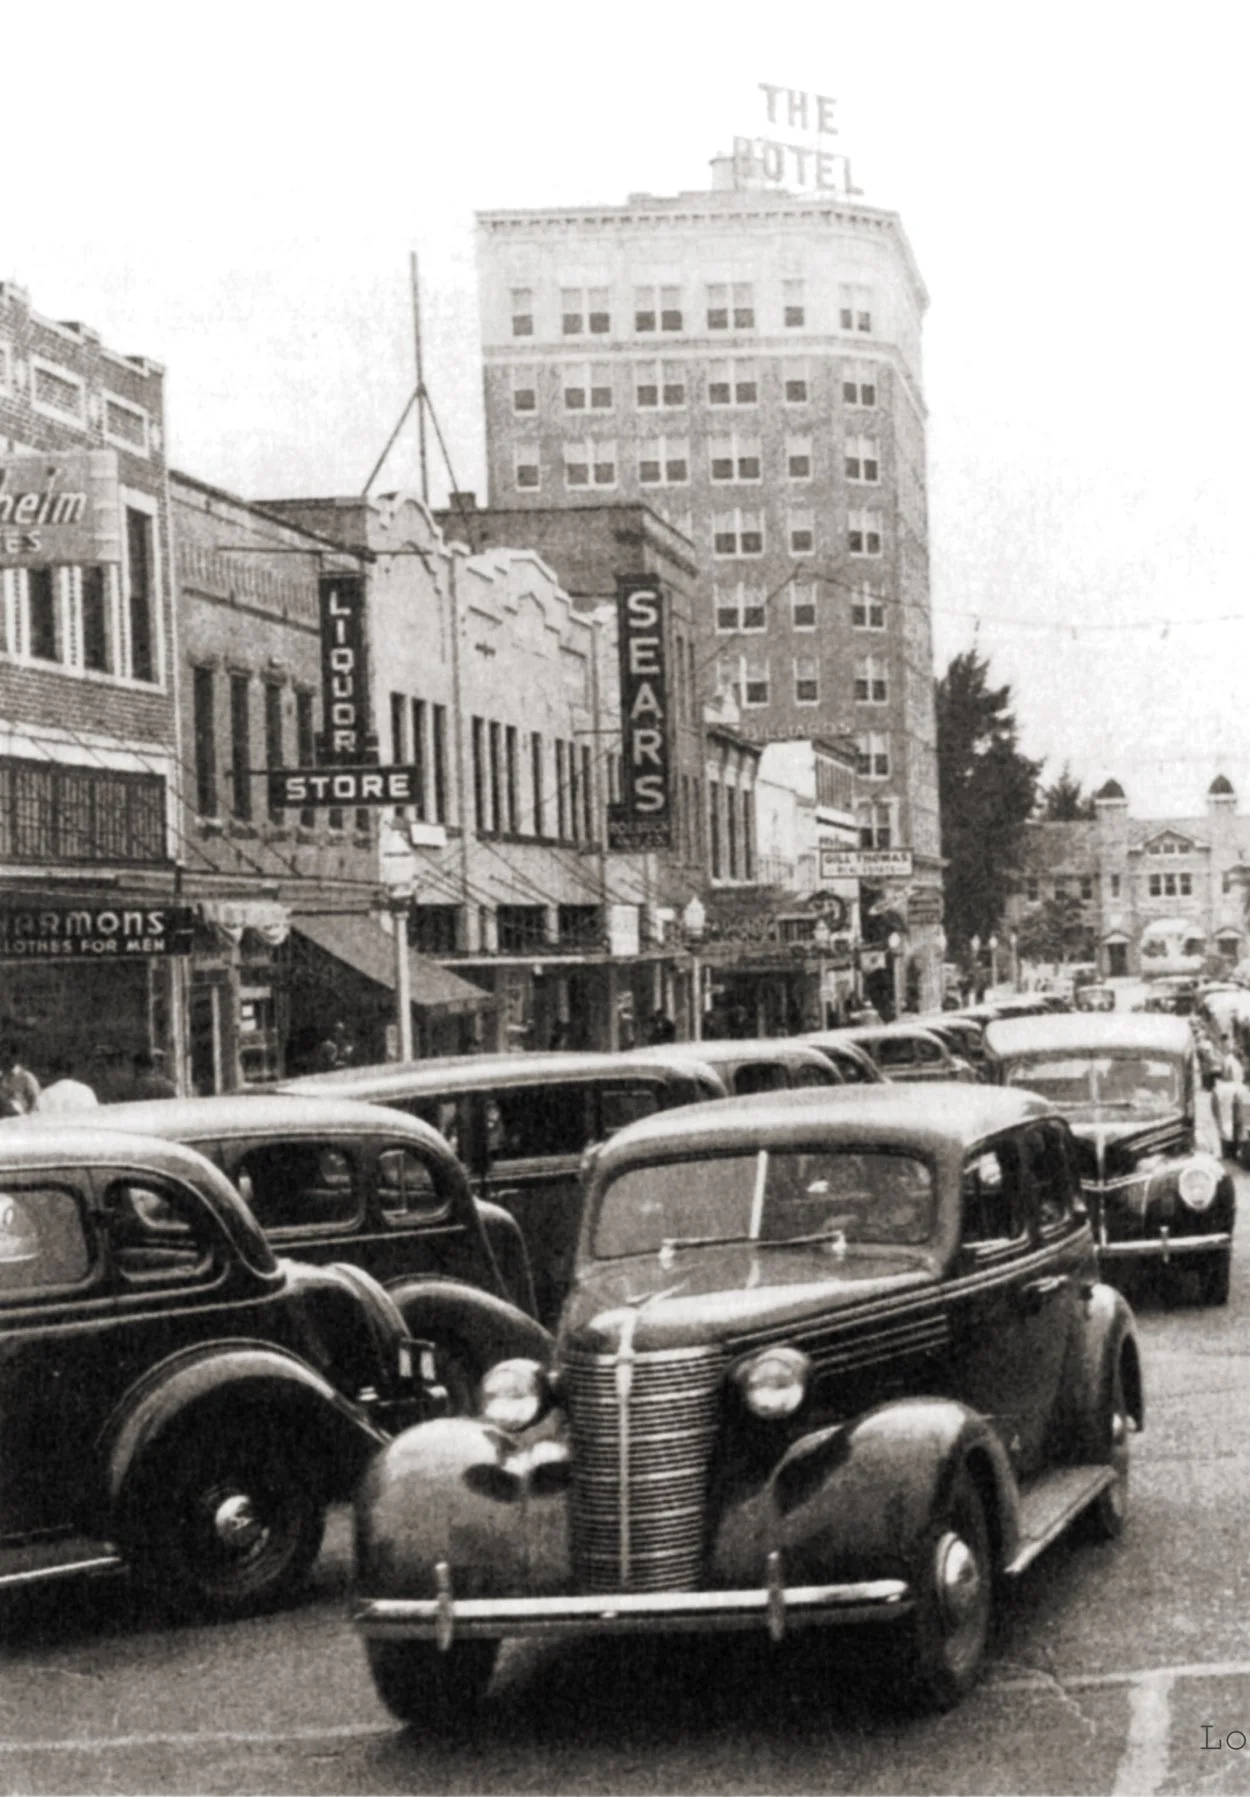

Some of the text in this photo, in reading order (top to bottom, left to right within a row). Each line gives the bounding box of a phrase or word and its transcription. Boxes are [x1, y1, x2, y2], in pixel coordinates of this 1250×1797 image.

[757, 82, 839, 135] THE
[732, 136, 864, 196] HOTEL
[329, 591, 356, 752] LIQUOR
[627, 590, 665, 812] SEARS
[285, 774, 410, 800] STORE
[80, 938, 118, 952] FOR
[126, 938, 166, 952] MEN
